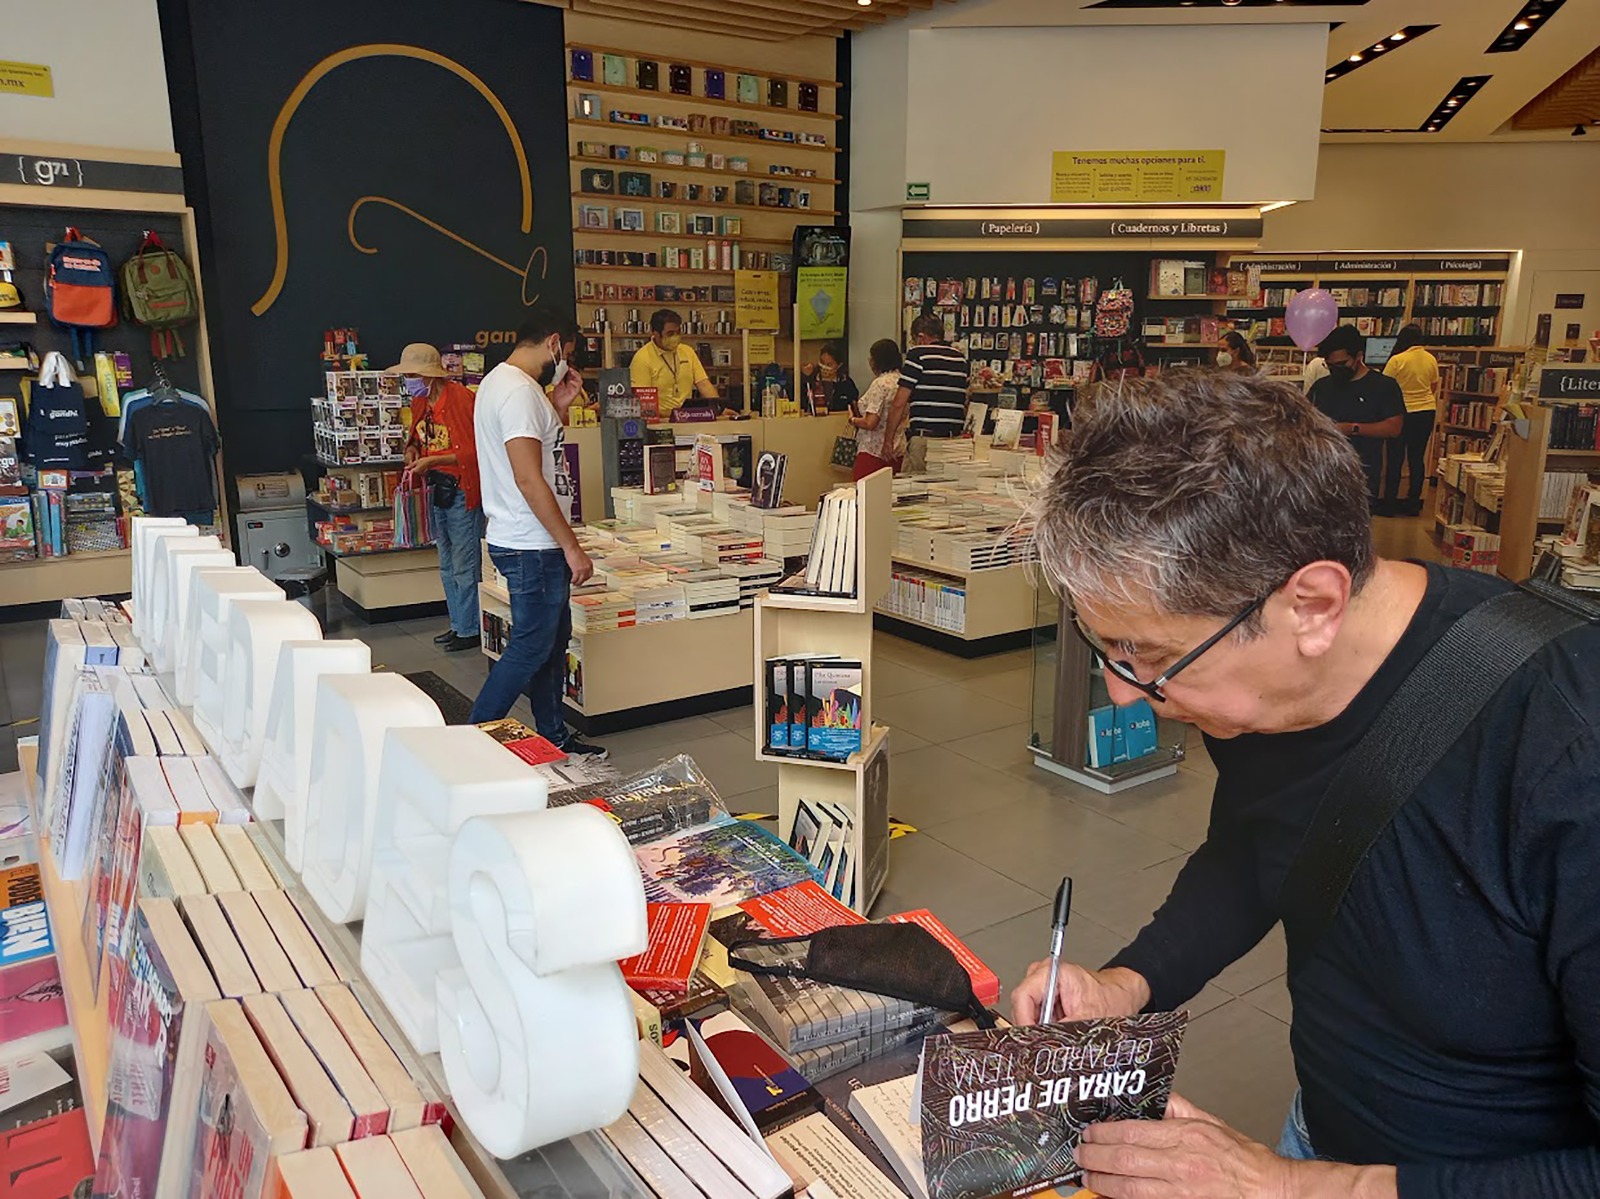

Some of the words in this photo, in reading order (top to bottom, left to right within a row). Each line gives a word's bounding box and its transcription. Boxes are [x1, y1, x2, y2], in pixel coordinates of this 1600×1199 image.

[1072, 156, 1107, 165] Tenemos
[1109, 156, 1140, 165] muchas
[1141, 157, 1176, 166] opciones
[1177, 156, 1195, 166] para
[988, 222, 1033, 235] Papelería
[1117, 223, 1170, 234] Cuadernos
[1171, 225, 1179, 235] y
[1180, 222, 1221, 233] Libretas
[1339, 262, 1392, 270] Administración
[1, 901, 50, 957] BIEN
[951, 1052, 1014, 1087] TENA
[1033, 1038, 1153, 1077] GERARDO
[1037, 1081, 1071, 1109] DE
[1079, 1069, 1147, 1103] CARA
[948, 1083, 1033, 1128] PERRO
